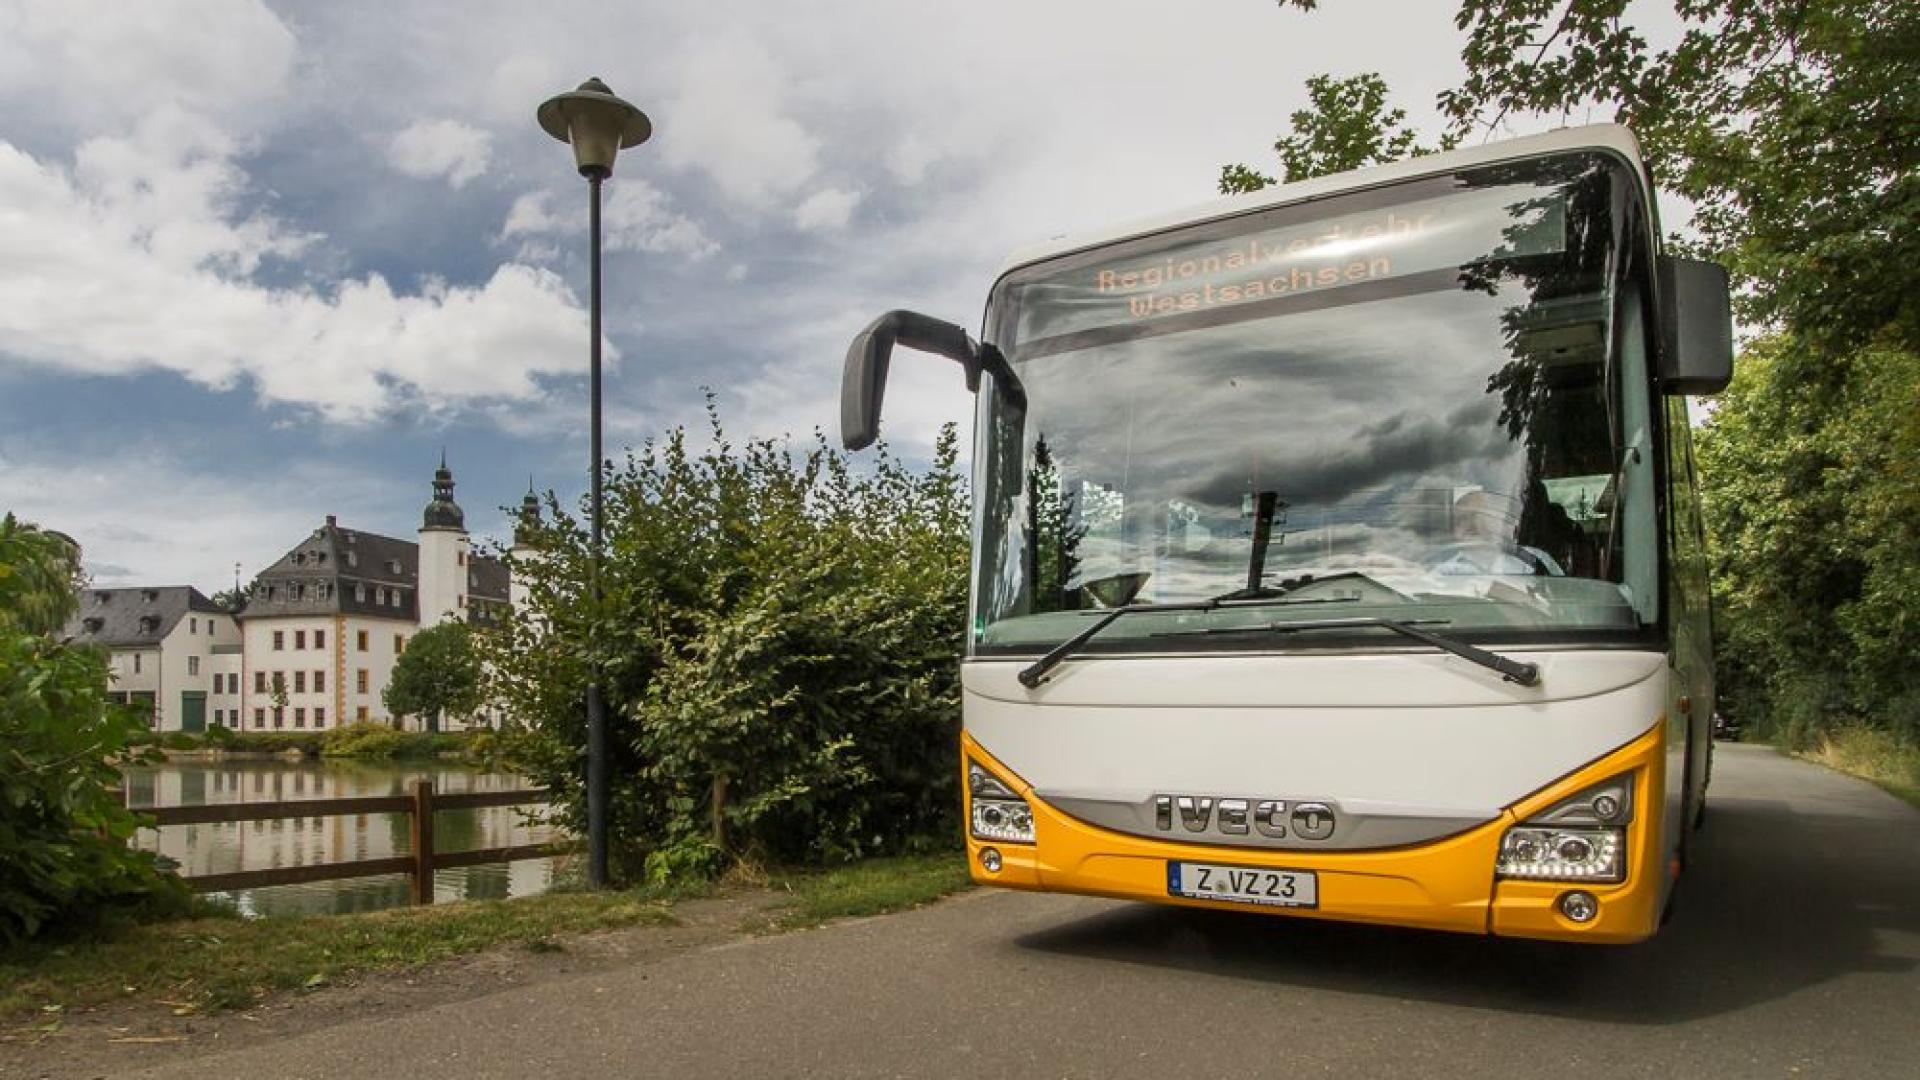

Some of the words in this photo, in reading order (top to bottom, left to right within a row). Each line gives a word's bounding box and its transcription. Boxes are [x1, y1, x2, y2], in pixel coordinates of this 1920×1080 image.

[1130, 254, 1392, 318] Westsachsen
[1155, 795, 1336, 840] IVECO
[1197, 868, 1212, 891] Z
[1228, 871, 1259, 895] VZ
[1265, 874, 1296, 898] 23
